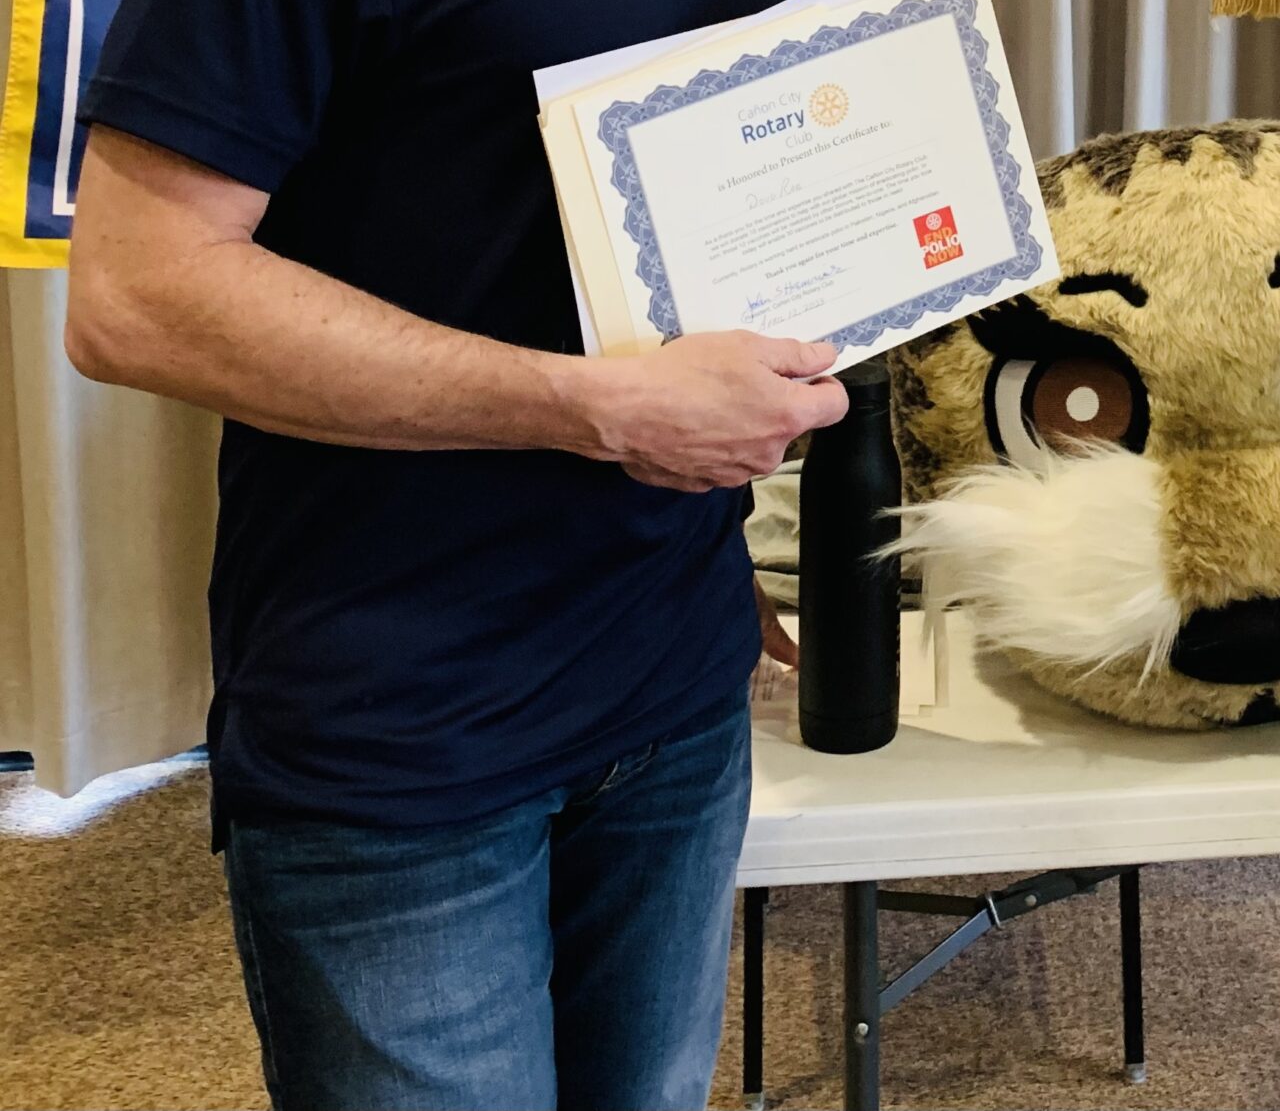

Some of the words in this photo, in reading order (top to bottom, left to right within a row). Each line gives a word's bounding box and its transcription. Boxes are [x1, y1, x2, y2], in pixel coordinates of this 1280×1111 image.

[738, 101, 776, 122] Cañon
[778, 92, 801, 106] City
[741, 110, 804, 144] Rotary
[785, 131, 813, 148] Club
[718, 184, 726, 192] is
[726, 164, 768, 188] Honored
[768, 163, 778, 171] to
[780, 148, 813, 167] Present
[814, 143, 831, 153] this
[832, 126, 878, 146] Certificate
[919, 234, 961, 254] POLIO
[924, 227, 952, 246] END
[928, 245, 960, 266] NOW
